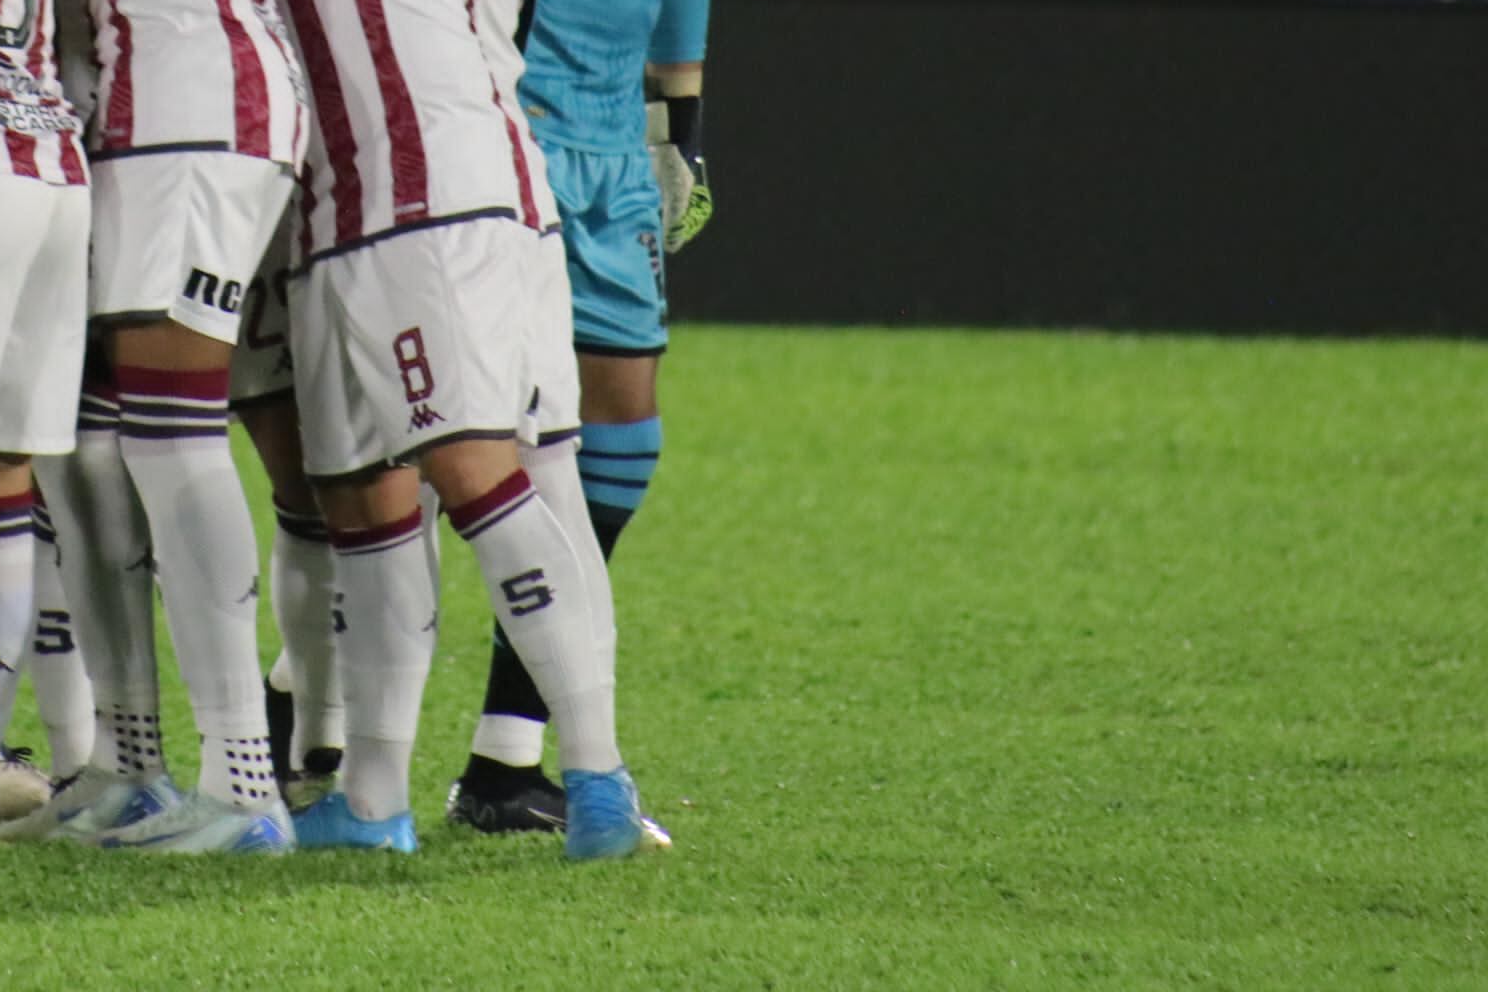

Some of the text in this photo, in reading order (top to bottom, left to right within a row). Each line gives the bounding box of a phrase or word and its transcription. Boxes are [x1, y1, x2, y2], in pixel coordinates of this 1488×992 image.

[183, 268, 242, 315] RC
[393, 326, 435, 404] 8
[500, 568, 553, 617] S
